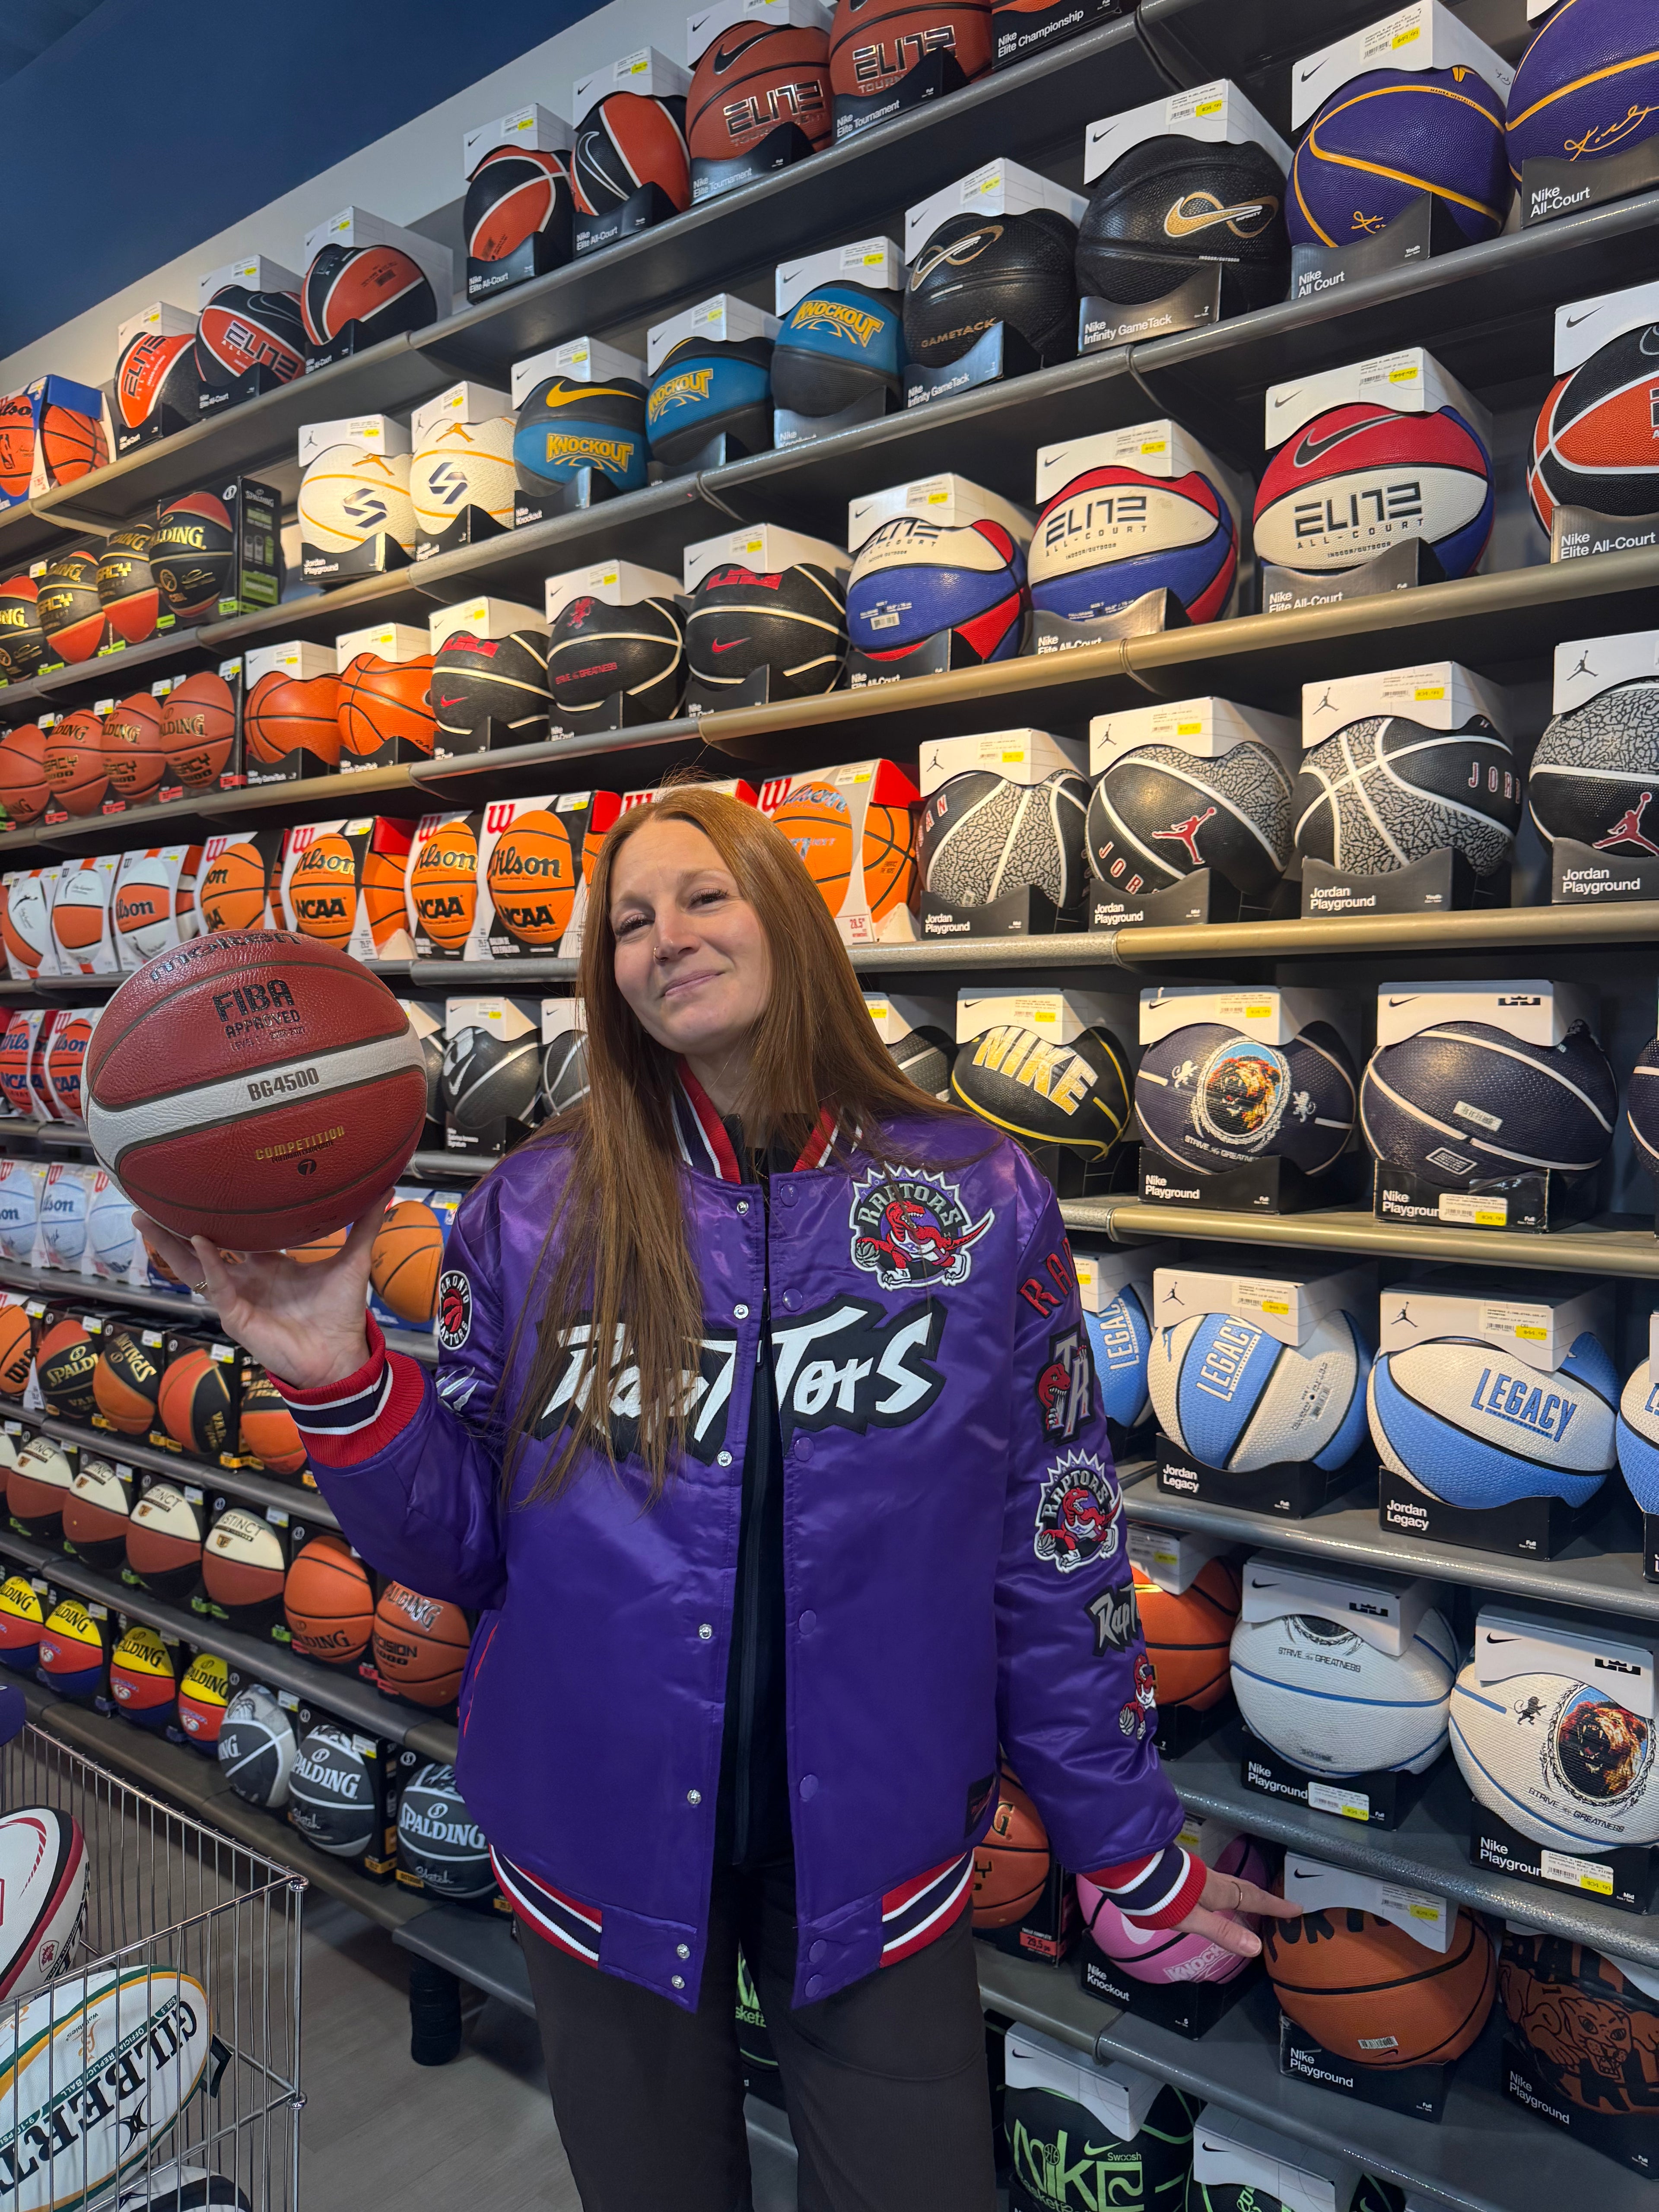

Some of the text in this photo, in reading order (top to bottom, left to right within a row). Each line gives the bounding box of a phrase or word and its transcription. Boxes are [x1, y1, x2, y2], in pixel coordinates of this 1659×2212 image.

[998, 10, 1084, 58] Elite Championship
[998, 32, 1017, 48] Nike
[1397, 30, 1419, 44] $49.99
[853, 25, 956, 83] ELITE
[724, 79, 823, 137] ELITE
[1430, 88, 1476, 108] MAMBA MENTALITY
[837, 113, 853, 127] Nike
[854, 100, 900, 128] Tournament
[693, 176, 709, 188] Nike
[693, 167, 752, 198] Elite Tournament
[1530, 187, 1590, 218] All-Court
[1531, 187, 1560, 205] Nike
[576, 230, 590, 242] Nike
[576, 226, 618, 251] Elite All-Court
[482, 273, 509, 288] All-Court
[1298, 270, 1322, 286] Nike
[1298, 272, 1345, 298] All Court
[790, 300, 885, 347] KNOCKOUT
[921, 318, 996, 348] GAMETACK
[1084, 315, 1172, 345] Infinity GameTack
[1085, 321, 1106, 334] Nike
[648, 369, 713, 421] KNOCKOUT
[908, 384, 923, 398] Nike
[931, 374, 970, 397] GameTack
[546, 433, 634, 472] KNOCKOUT
[1294, 481, 1423, 538] ELITE
[1046, 496, 1147, 548] ELITE
[1045, 525, 1147, 558] ALL-COURT
[1297, 518, 1424, 550] ALL-COURT
[1560, 533, 1590, 547] Nike
[1327, 541, 1392, 558] INDOOR/OUTDOOR
[1560, 532, 1656, 559] Elite All-Court
[1269, 591, 1293, 604] Nike
[1294, 592, 1343, 610] All-Court
[1038, 635, 1059, 646] Nike
[1060, 637, 1102, 651] All-Court
[851, 673, 868, 683] Nike
[1562, 868, 1609, 881] Jordan
[1309, 886, 1351, 899] Jordan
[1562, 878, 1640, 895] Playground
[1094, 903, 1124, 913] Jordan
[1309, 895, 1376, 911] Playground
[925, 913, 953, 924] Jordan
[925, 921, 971, 934] Playground
[1094, 911, 1144, 925] Playground
[213, 979, 295, 1023] FIBA
[224, 1010, 300, 1039] APPROVED
[972, 1026, 1098, 1116] NIKE
[248, 1067, 320, 1102] BG4500
[255, 1125, 345, 1160] COMPETITION
[1185, 1135, 1256, 1163] STRIVE GREATN
[1145, 1175, 1167, 1187] Nike
[1145, 1185, 1200, 1200] Playground
[1383, 1190, 1410, 1203] Nike
[858, 1182, 963, 1228] RAPTORS
[1383, 1201, 1439, 1217] Playgroun
[1100, 1297, 1140, 1371] LEGAC
[1197, 1314, 1262, 1402] LEGACY
[1470, 1368, 1577, 1443] LEGACY
[1163, 1464, 1197, 1480] Jordan
[1042, 1469, 1109, 1519] RAPTORS
[1163, 1475, 1199, 1493] Legacy
[1387, 1499, 1427, 1517] Jordan
[1387, 1511, 1429, 1531] Legacy
[1278, 1646, 1361, 1673] STRIVE GREATNESS
[1248, 1761, 1271, 1777] Nike
[1248, 1772, 1309, 1800] Playground
[1529, 1787, 1624, 1833] STRIVE GREATNESS
[402, 1802, 486, 1849] SPALDING
[1480, 1837, 1508, 1854] Nike
[1480, 1849, 1541, 1877] Playgroun
[1586, 1880, 1611, 1892] $34.99
[1027, 1936, 1043, 1949] 29.5
[1087, 1963, 1107, 1980] Nike
[1087, 1973, 1131, 2002] Knockout
[1290, 2047, 1315, 2064] Nike
[1290, 2058, 1354, 2088] Playground
[1510, 2071, 1532, 2092] Nike
[0, 2000, 197, 2196] GILBERT
[1510, 2082, 1570, 2124] Playground
[1107, 2152, 1142, 2161] Swoosh
